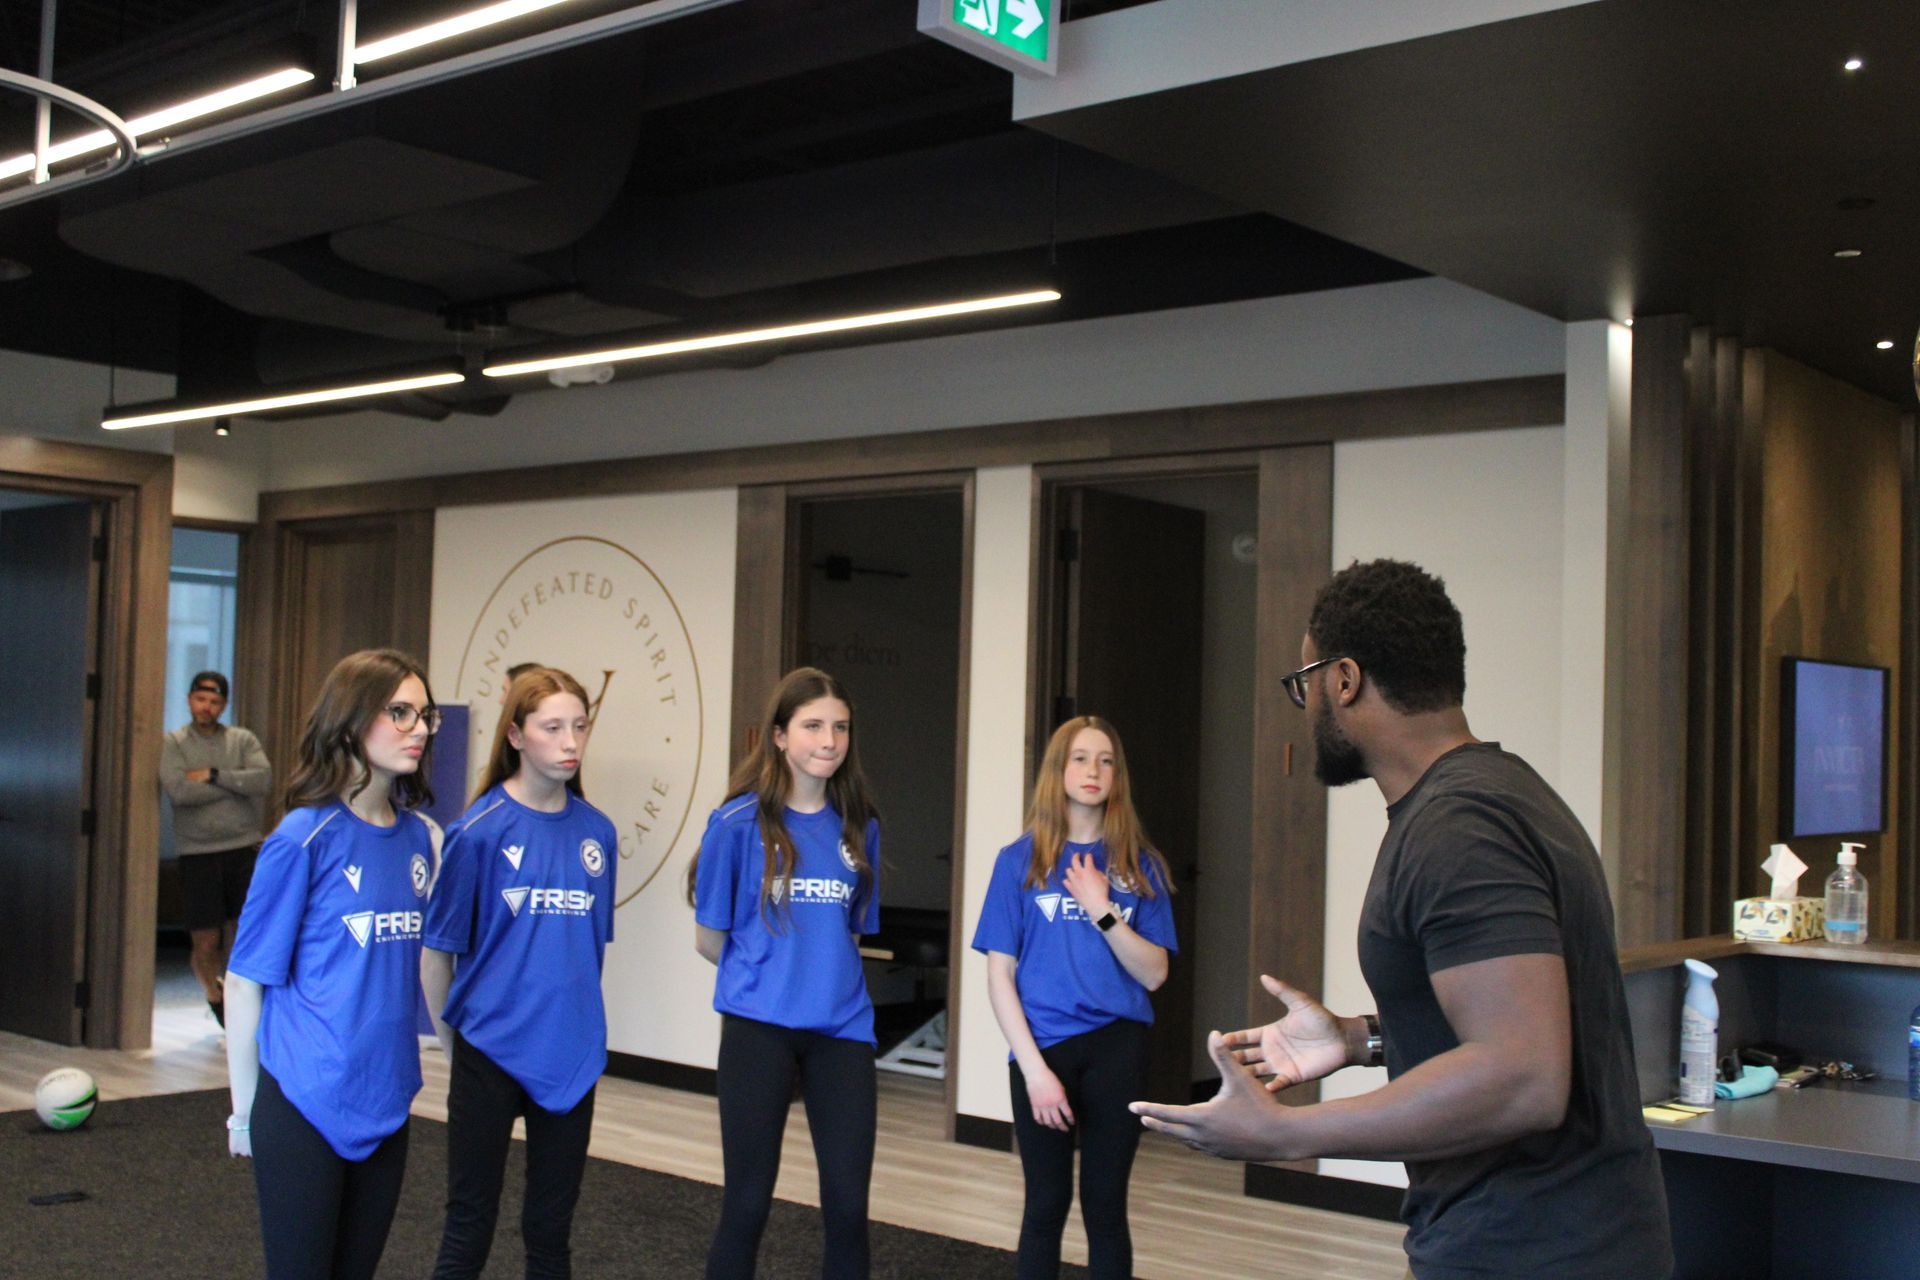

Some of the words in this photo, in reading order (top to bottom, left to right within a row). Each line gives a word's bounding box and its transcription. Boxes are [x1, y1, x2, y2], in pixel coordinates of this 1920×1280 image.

[477, 571, 614, 698] UNDEFEATED
[623, 597, 676, 705] SPIRIT
[618, 777, 669, 860] CARE
[375, 911, 424, 936] PRIS
